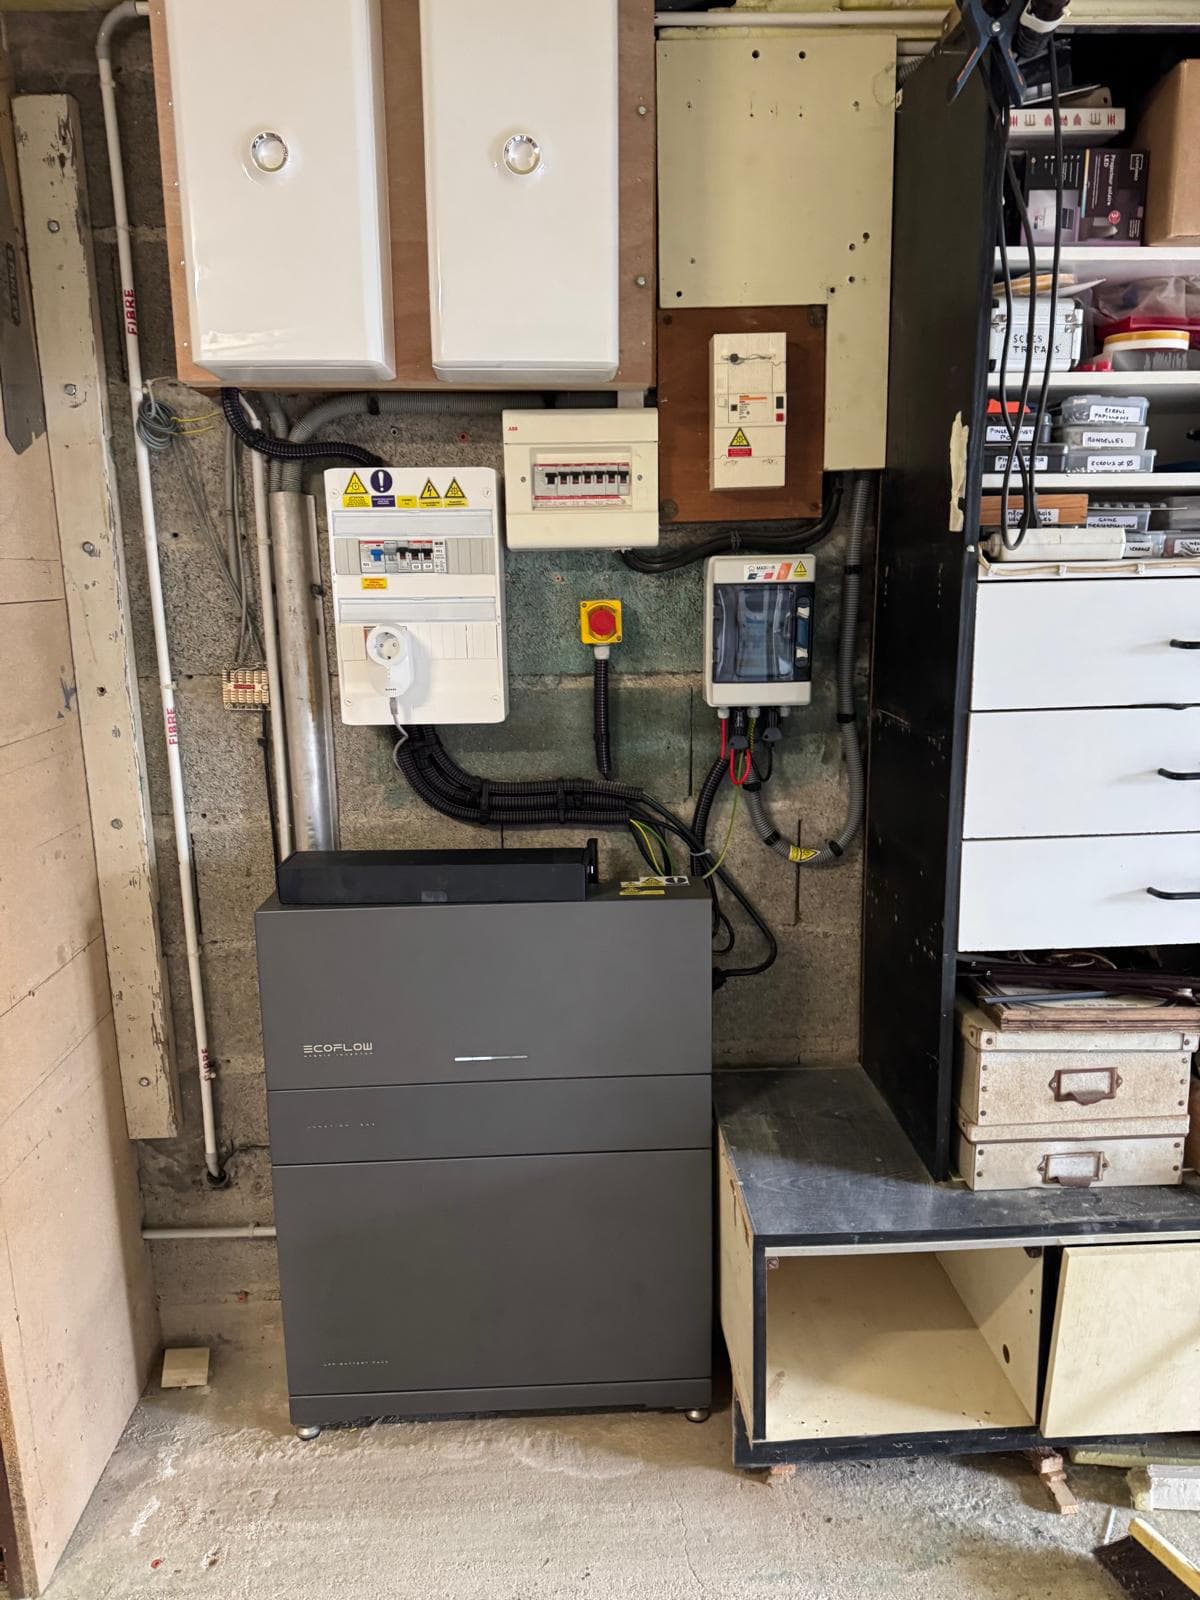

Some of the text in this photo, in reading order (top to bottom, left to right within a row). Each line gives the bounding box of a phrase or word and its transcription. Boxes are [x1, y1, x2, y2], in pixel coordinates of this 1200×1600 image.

[123, 289, 138, 335] FIBRE
[166, 707, 178, 745] FIBRE
[303, 1042, 373, 1054] ECOFLOW
